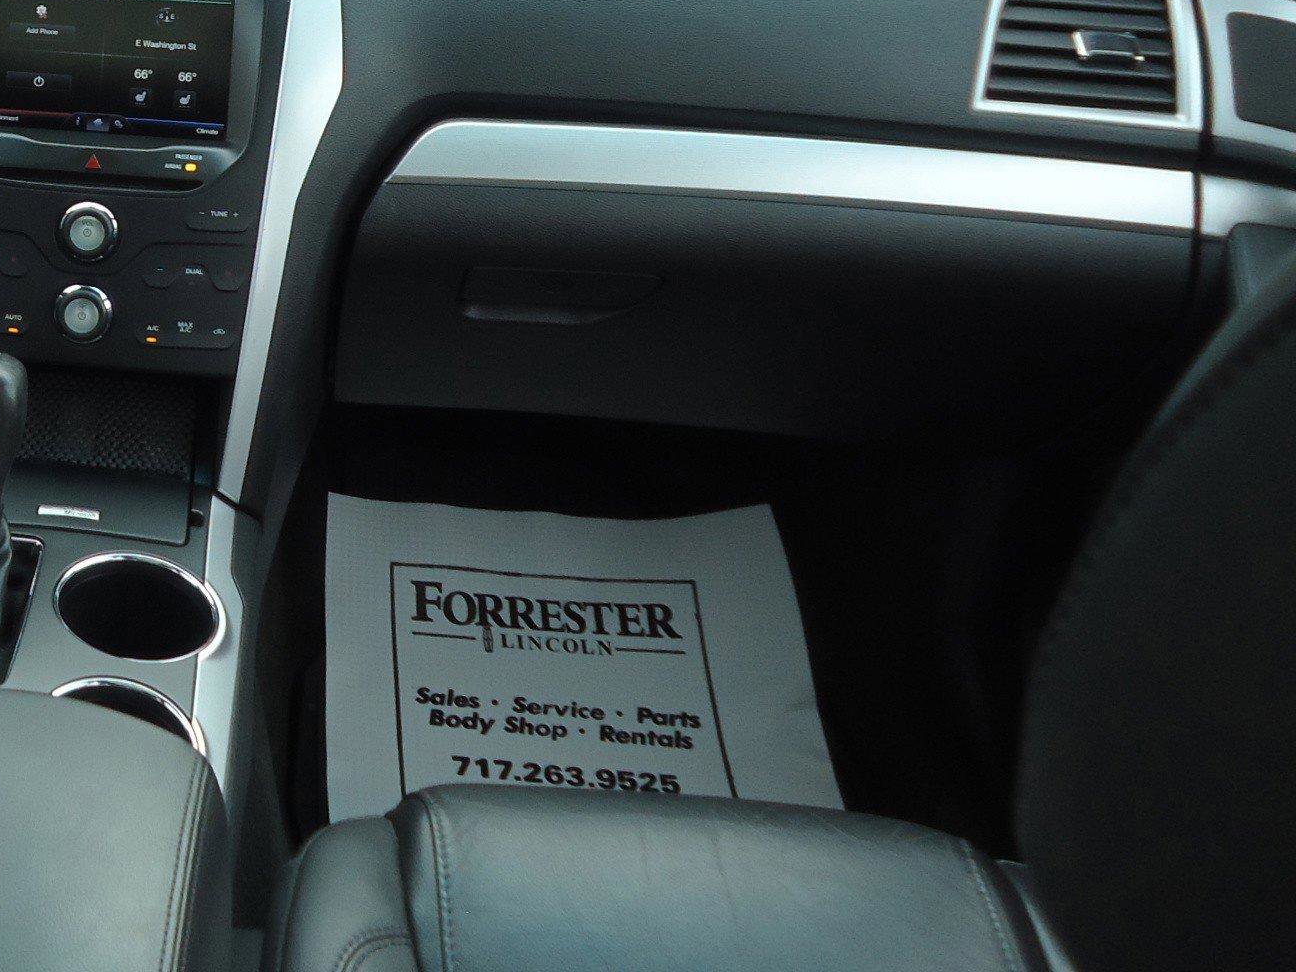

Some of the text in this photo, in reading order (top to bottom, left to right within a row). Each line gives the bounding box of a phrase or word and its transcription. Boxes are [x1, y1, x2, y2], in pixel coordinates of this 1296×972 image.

[135, 39, 197, 50] E Washington St
[134, 68, 153, 79] 66°
[178, 71, 197, 82] 66°
[410, 580, 684, 639] FORRESTER
[500, 634, 616, 656] LINCOLN
[415, 686, 703, 730] Sales Service Parts
[429, 708, 694, 750] Body Shop Rentals
[450, 754, 682, 795] 717.263.9525
